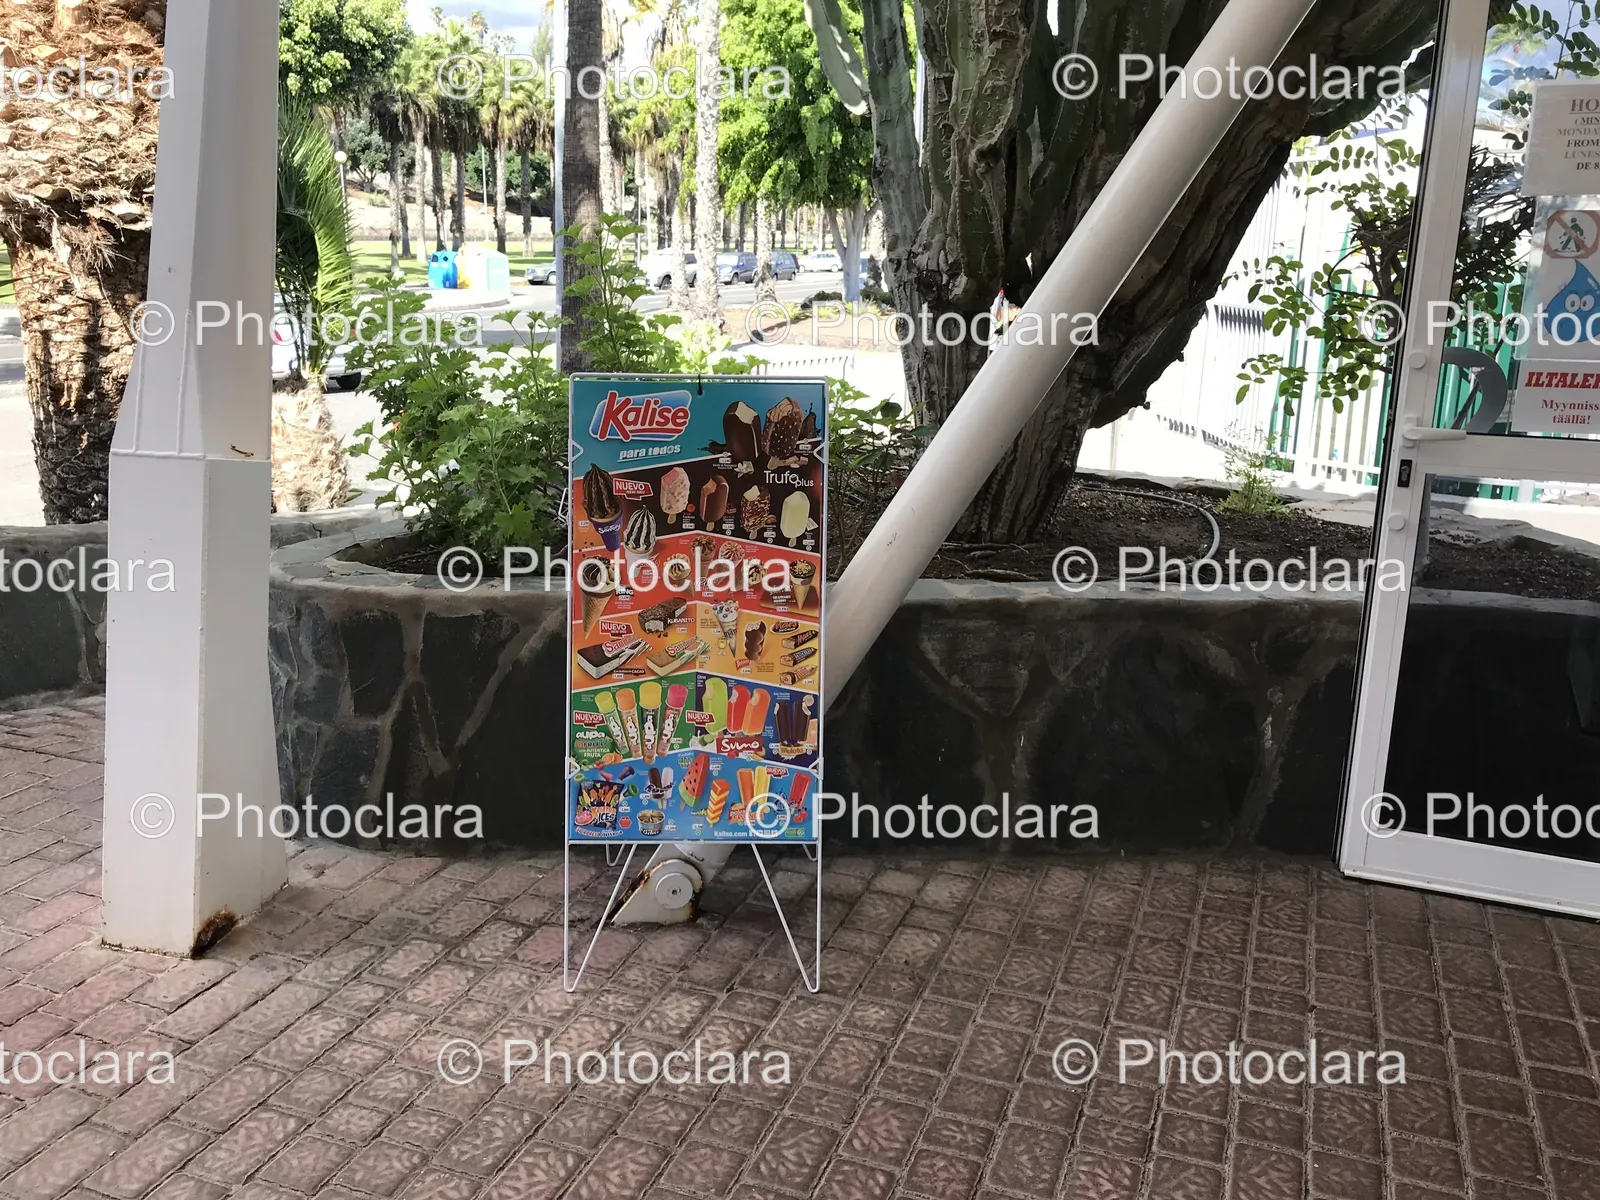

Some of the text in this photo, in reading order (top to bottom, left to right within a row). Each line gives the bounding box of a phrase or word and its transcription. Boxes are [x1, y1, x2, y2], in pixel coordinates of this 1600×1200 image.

[1557, 127, 1600, 136] MONDA
[1567, 139, 1600, 147] FROM
[1576, 162, 1591, 170] DE
[1541, 399, 1600, 412] Myynniss
[599, 391, 689, 442] Kalise
[1552, 414, 1591, 425] täällä!
[620, 445, 681, 460] para todos
[616, 481, 644, 491] NUEVO
[795, 479, 814, 488] plus
[602, 622, 627, 631] NUEVO
[575, 713, 602, 721] NUEVOS
[688, 712, 709, 720] NUEVO
[721, 739, 760, 752] Sumo
[599, 813, 615, 821] ICES
